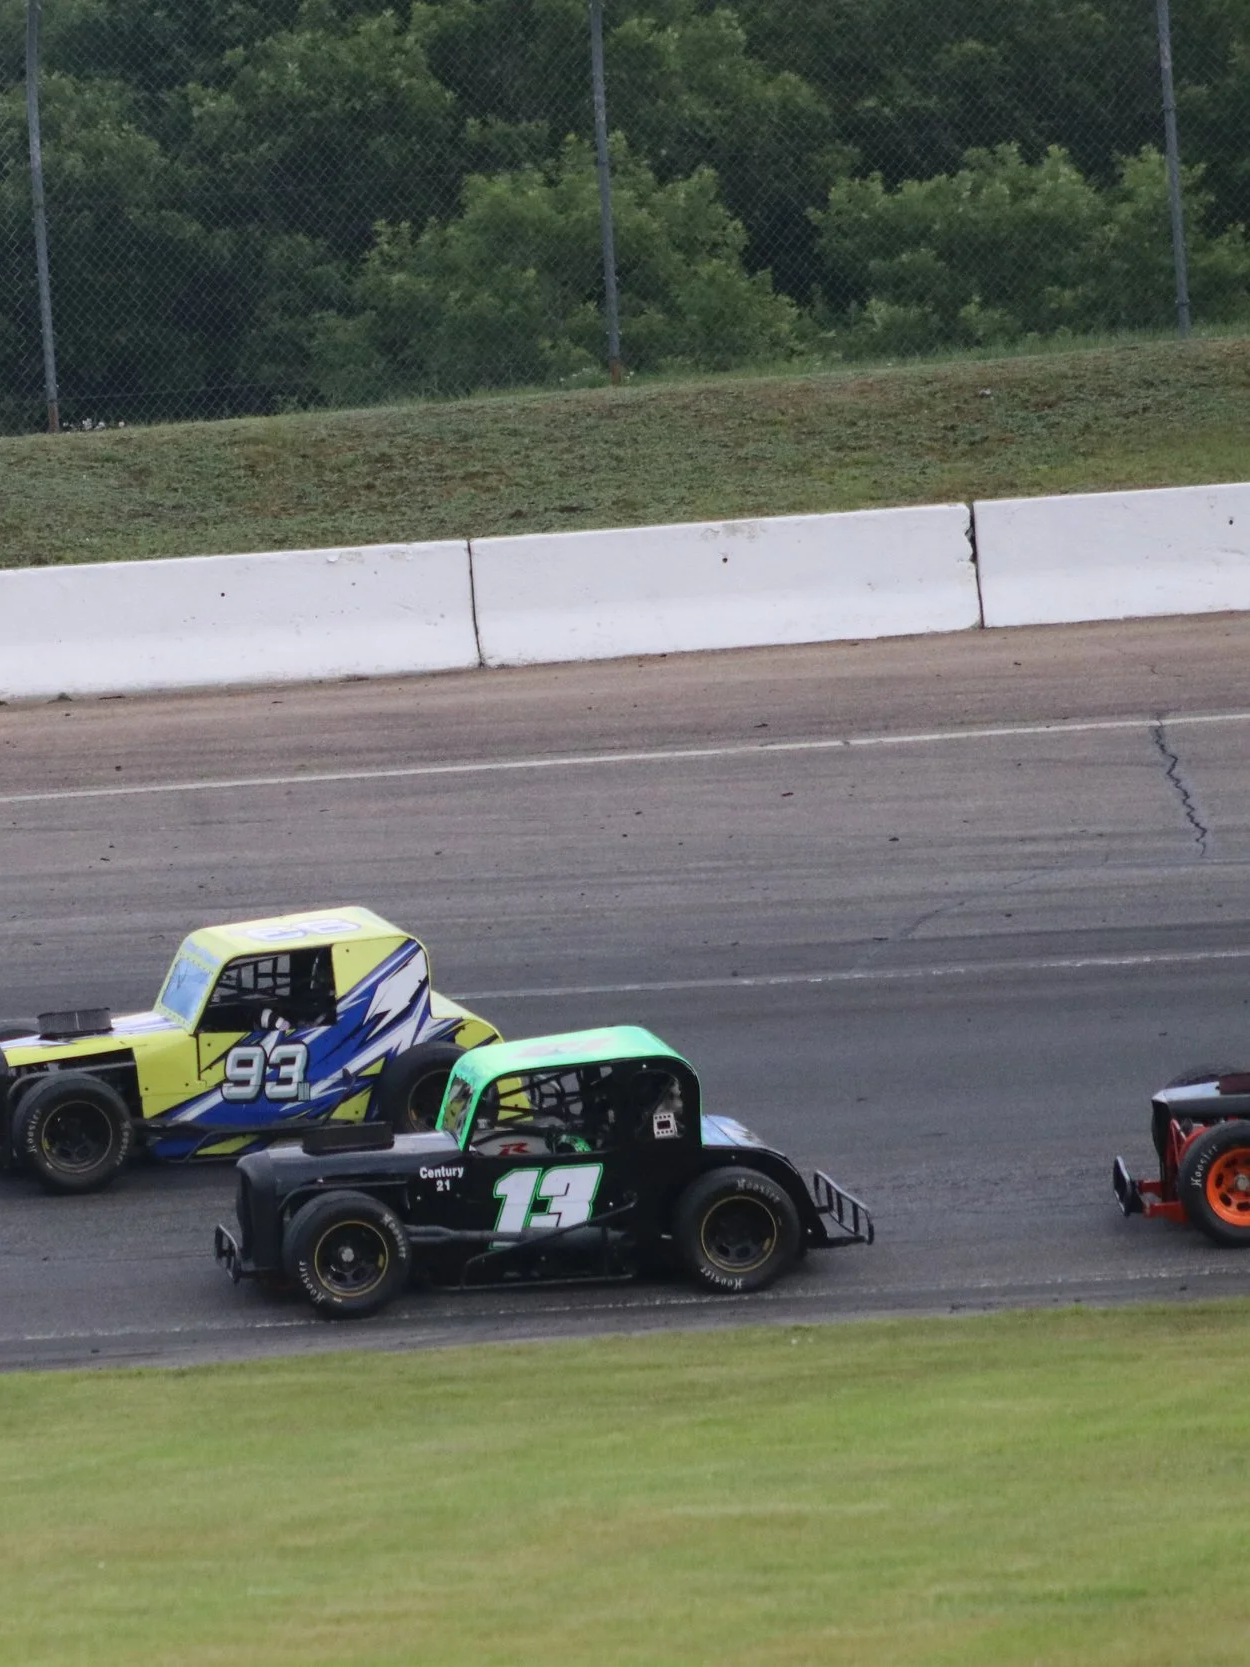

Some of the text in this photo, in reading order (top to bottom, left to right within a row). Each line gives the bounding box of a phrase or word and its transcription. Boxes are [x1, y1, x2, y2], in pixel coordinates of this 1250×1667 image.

[221, 1041, 309, 1103] 93
[419, 1166, 464, 1180] Century
[436, 1179, 450, 1192] 21
[1190, 1144, 1219, 1188] Hoosier
[488, 1163, 604, 1250] 13
